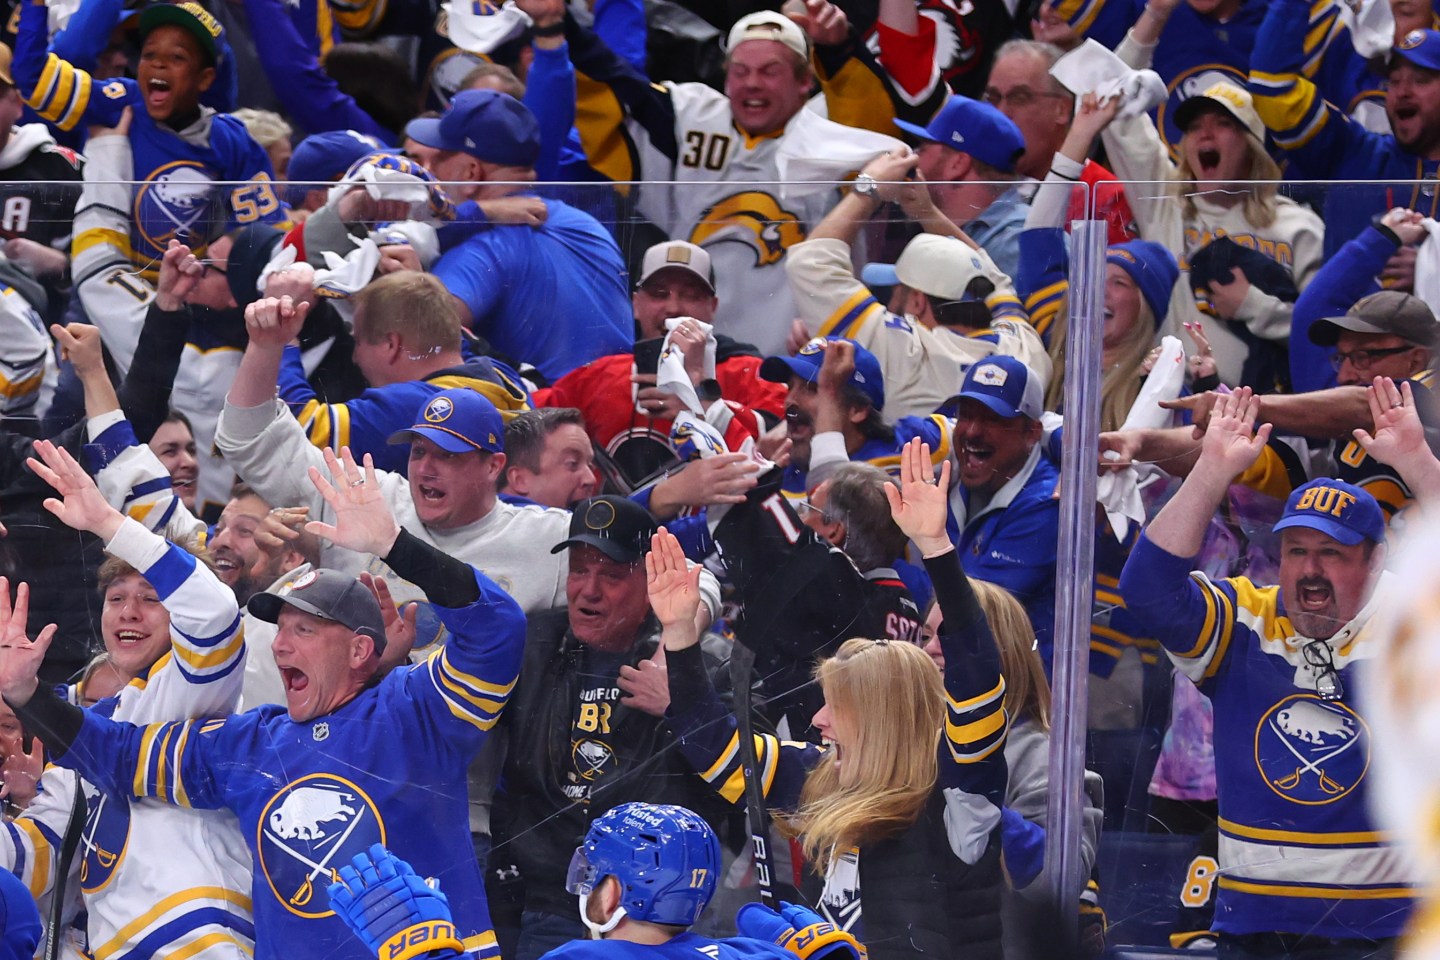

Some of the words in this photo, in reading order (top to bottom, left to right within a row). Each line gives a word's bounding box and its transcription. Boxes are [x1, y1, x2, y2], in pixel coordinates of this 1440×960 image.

[682, 130, 730, 171] 30
[2, 196, 32, 232] A
[231, 171, 280, 223] 53
[1295, 486, 1357, 518] BUF
[626, 805, 664, 827] Trusted
[689, 869, 708, 889] 17
